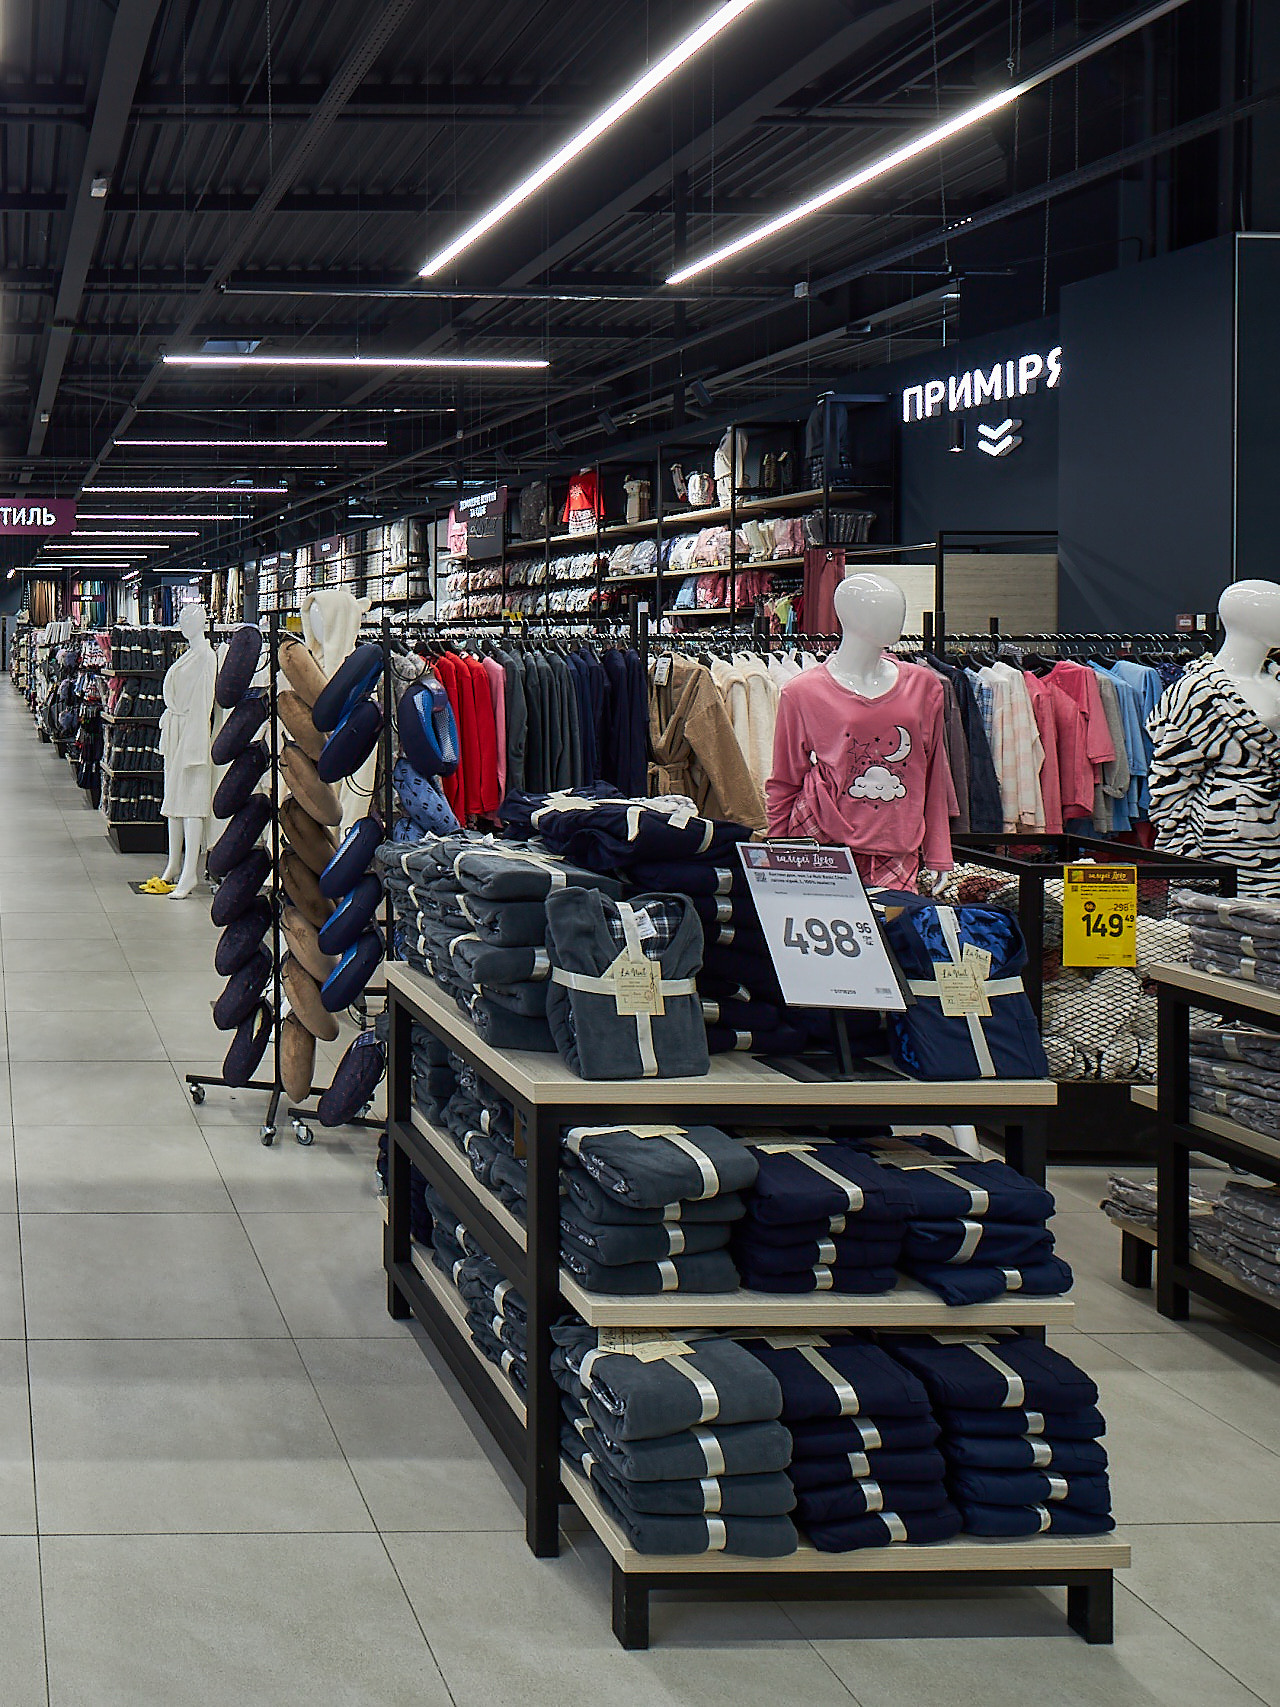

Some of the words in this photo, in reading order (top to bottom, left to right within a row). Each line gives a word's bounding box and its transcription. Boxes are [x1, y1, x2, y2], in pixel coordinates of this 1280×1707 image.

[783, 917, 861, 958] 498
[855, 922, 872, 934] 96
[1081, 913, 1124, 937] 149
[1124, 914, 1134, 922] 49
